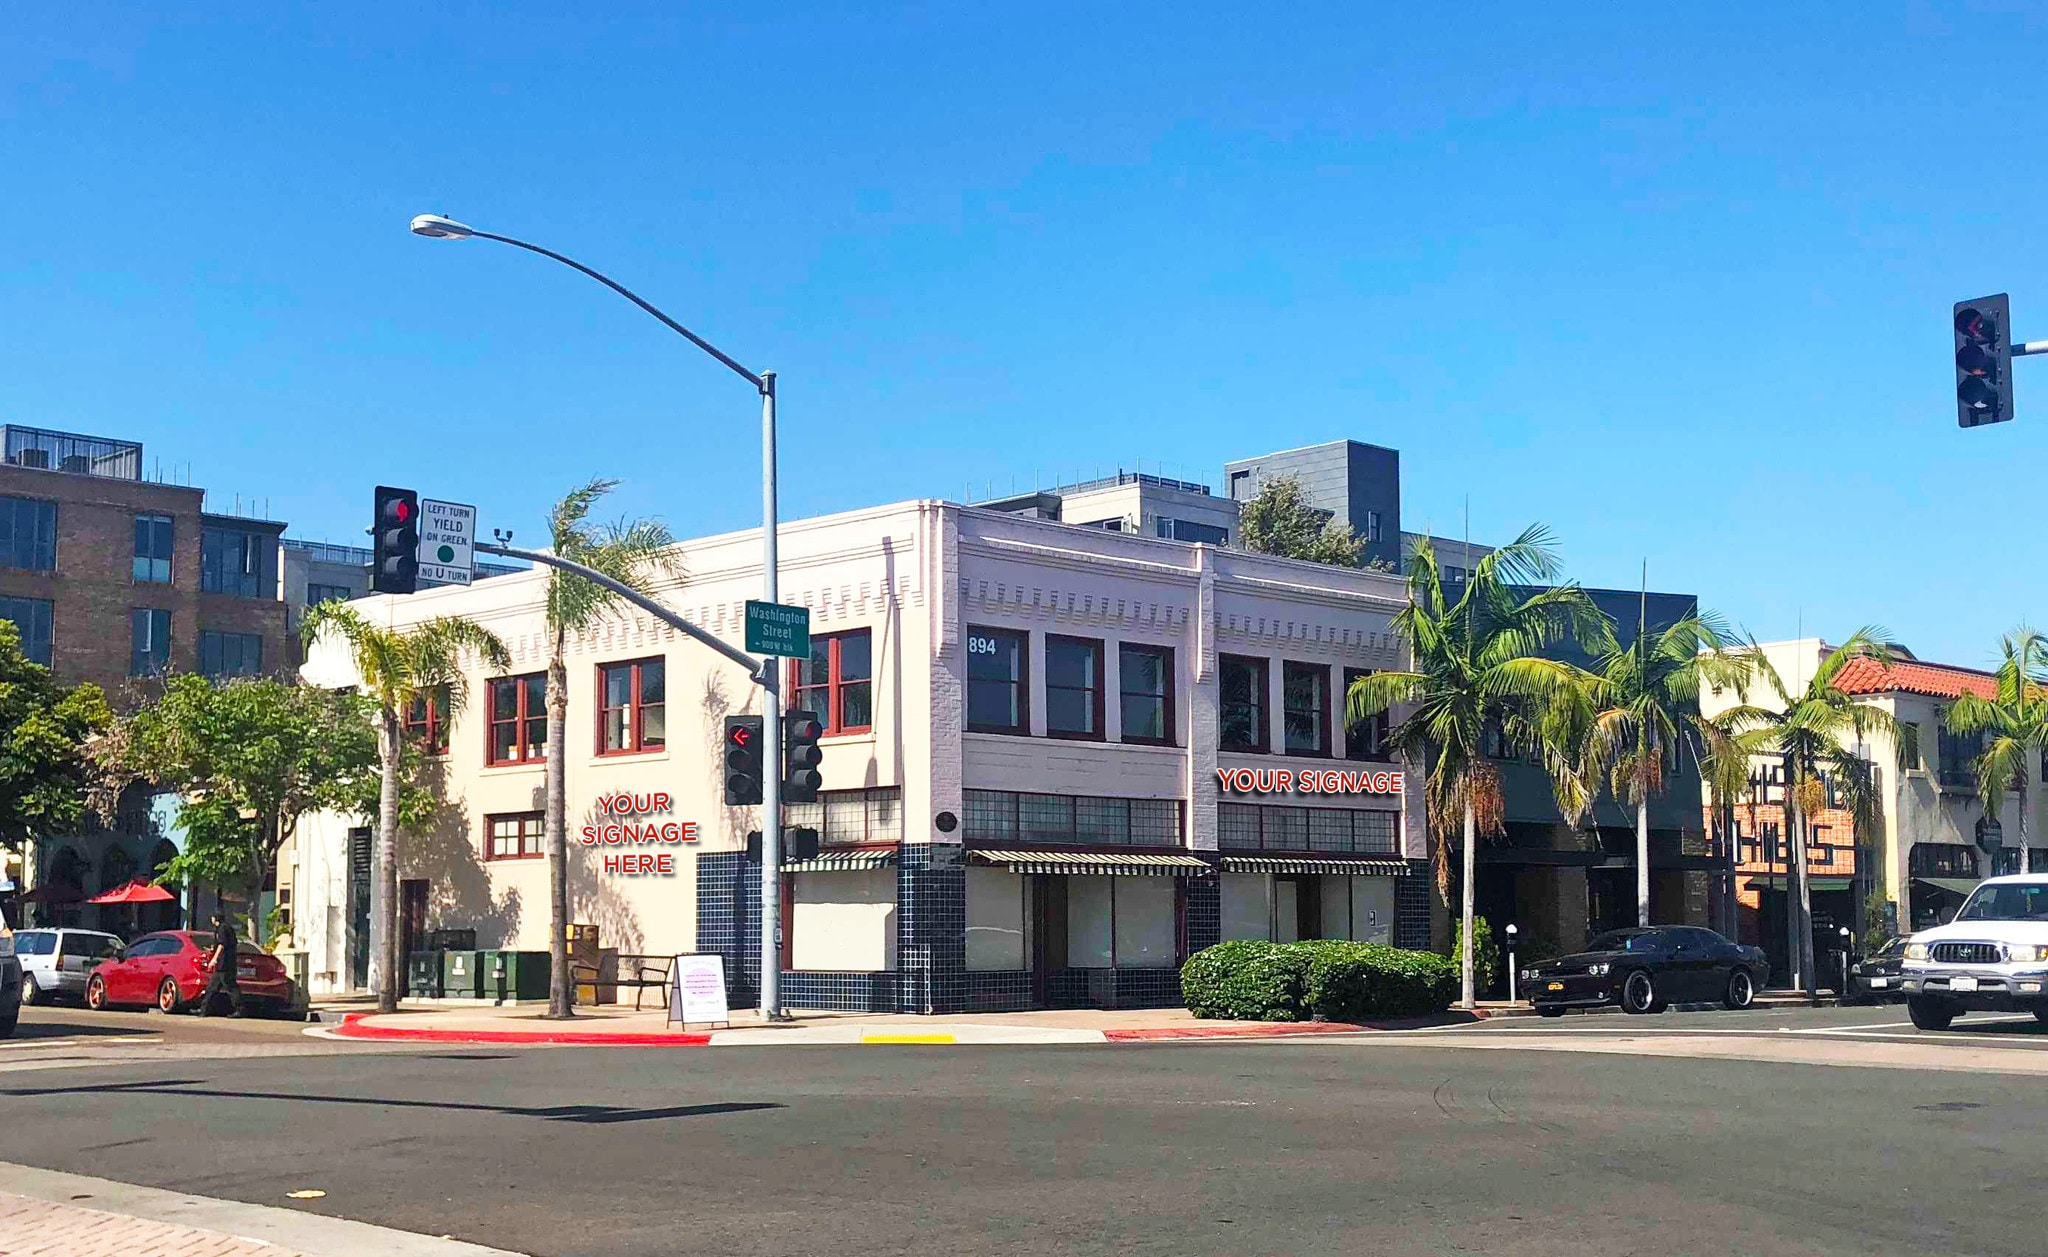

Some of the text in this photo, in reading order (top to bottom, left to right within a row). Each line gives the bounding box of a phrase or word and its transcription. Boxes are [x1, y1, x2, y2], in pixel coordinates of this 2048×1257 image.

[428, 504, 470, 519] LEFT TURN
[433, 518, 463, 533] YIELD
[426, 532, 467, 546] ON GREEN
[422, 567, 468, 582] NO U TURN
[749, 606, 806, 625] Washington
[762, 623, 792, 640] Street
[968, 636, 997, 655] 894
